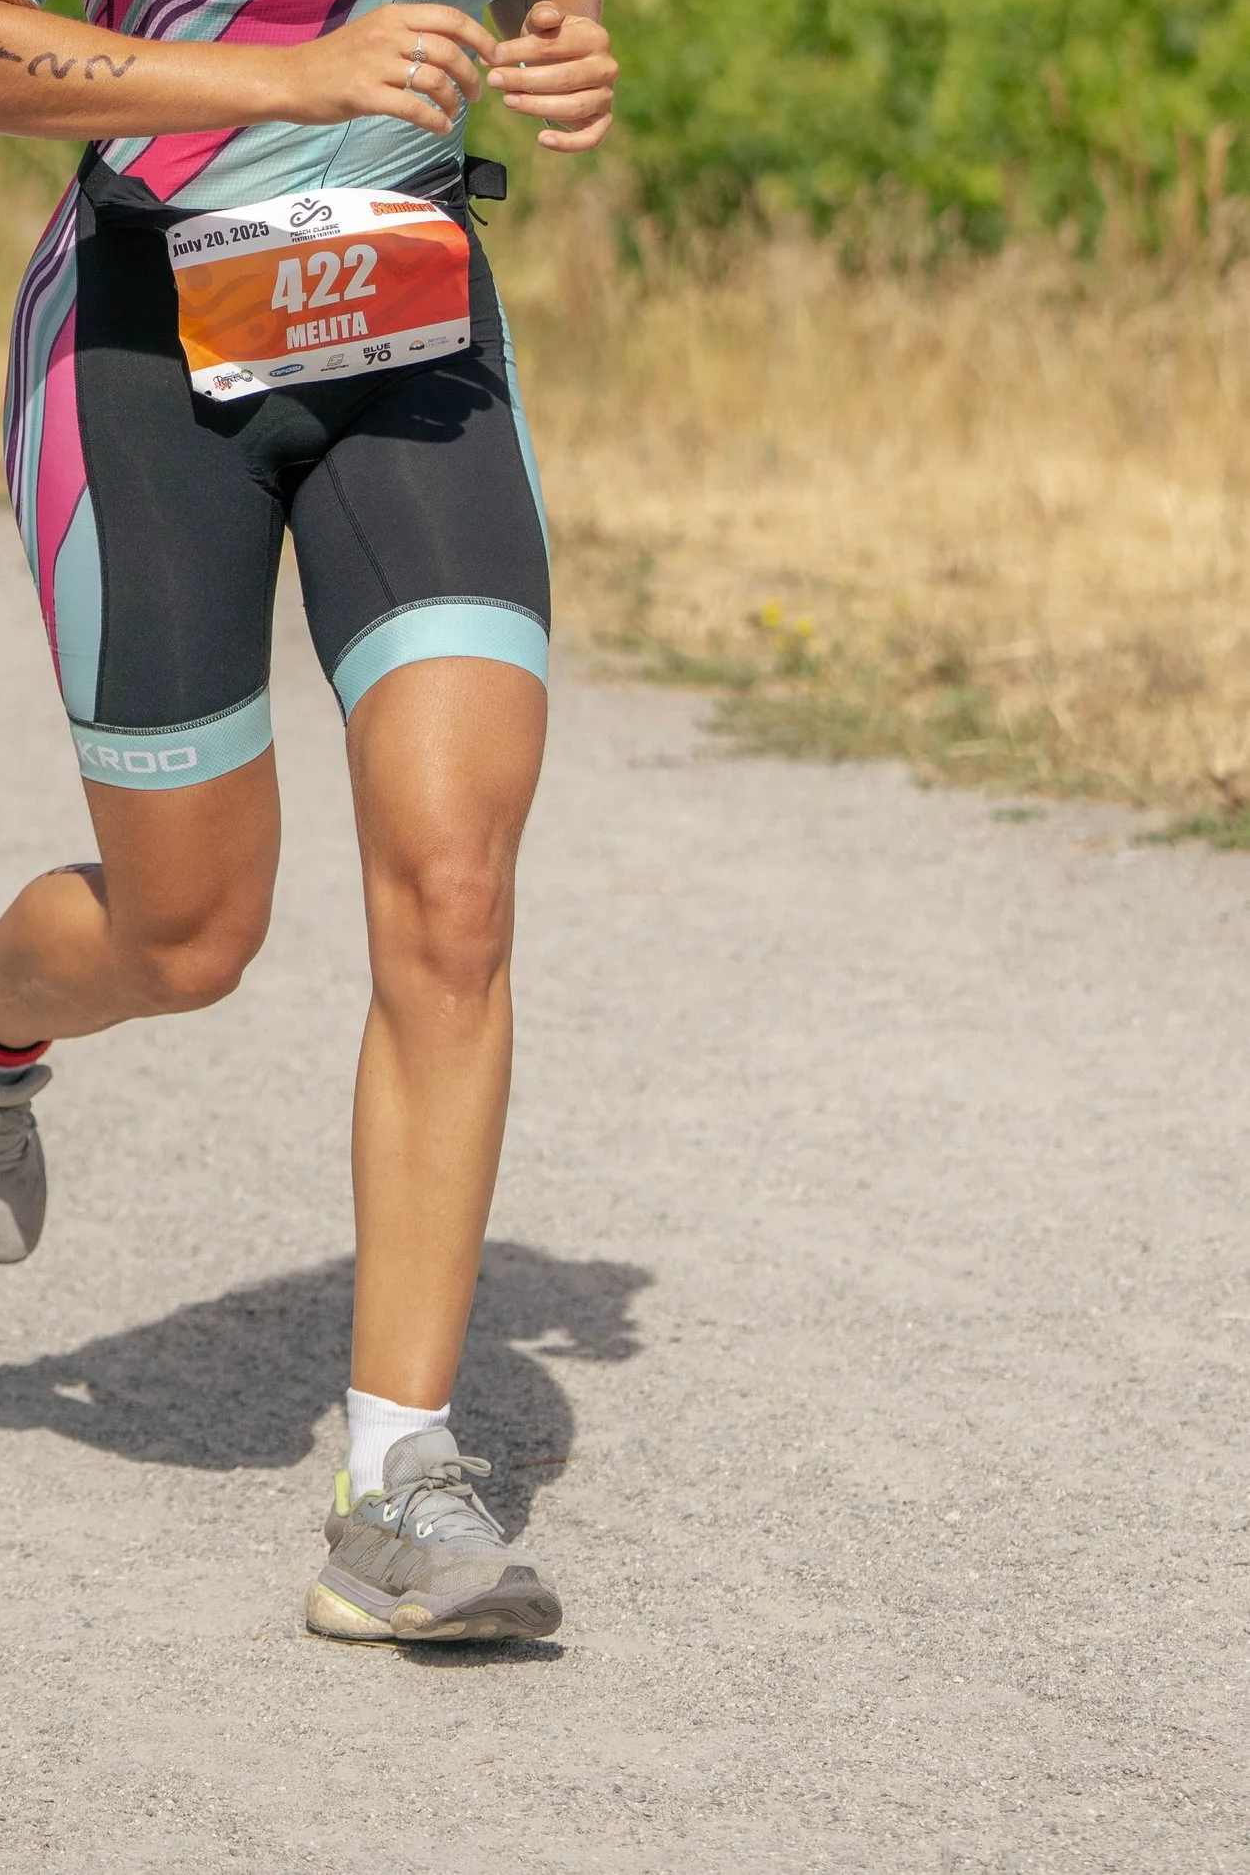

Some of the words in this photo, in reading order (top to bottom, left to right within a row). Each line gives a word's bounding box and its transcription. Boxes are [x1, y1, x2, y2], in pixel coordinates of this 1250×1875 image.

[173, 237, 202, 258] July
[204, 231, 229, 248] 20,
[230, 221, 270, 243] 2025
[271, 244, 378, 314] 422
[286, 311, 369, 350] MELITA
[363, 342, 391, 354] BLUE
[364, 350, 392, 365] 70
